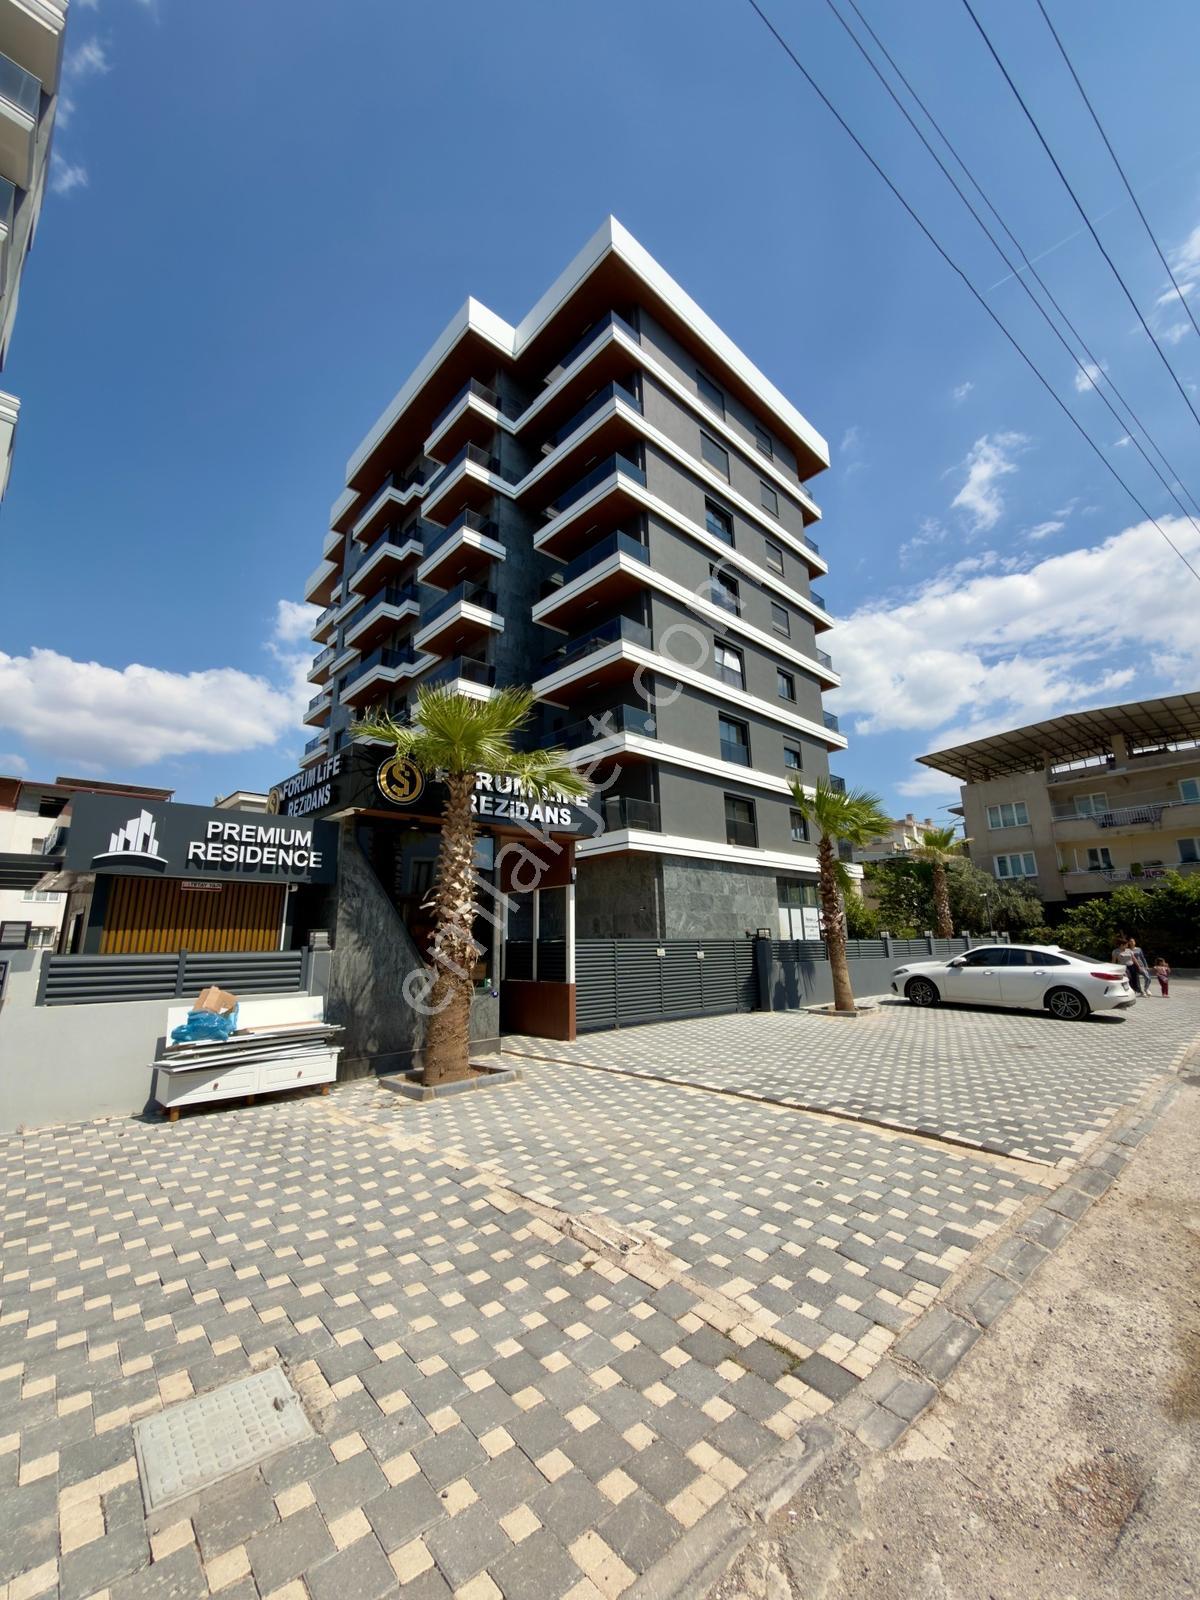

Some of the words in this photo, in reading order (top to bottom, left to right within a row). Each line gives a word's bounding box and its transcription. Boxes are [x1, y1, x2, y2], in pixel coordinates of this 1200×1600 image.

[282, 767, 316, 800] FORUM
[435, 768, 533, 798] FRUM
[207, 821, 311, 847] PREMIUM
[188, 841, 322, 868] RESIDENCE
